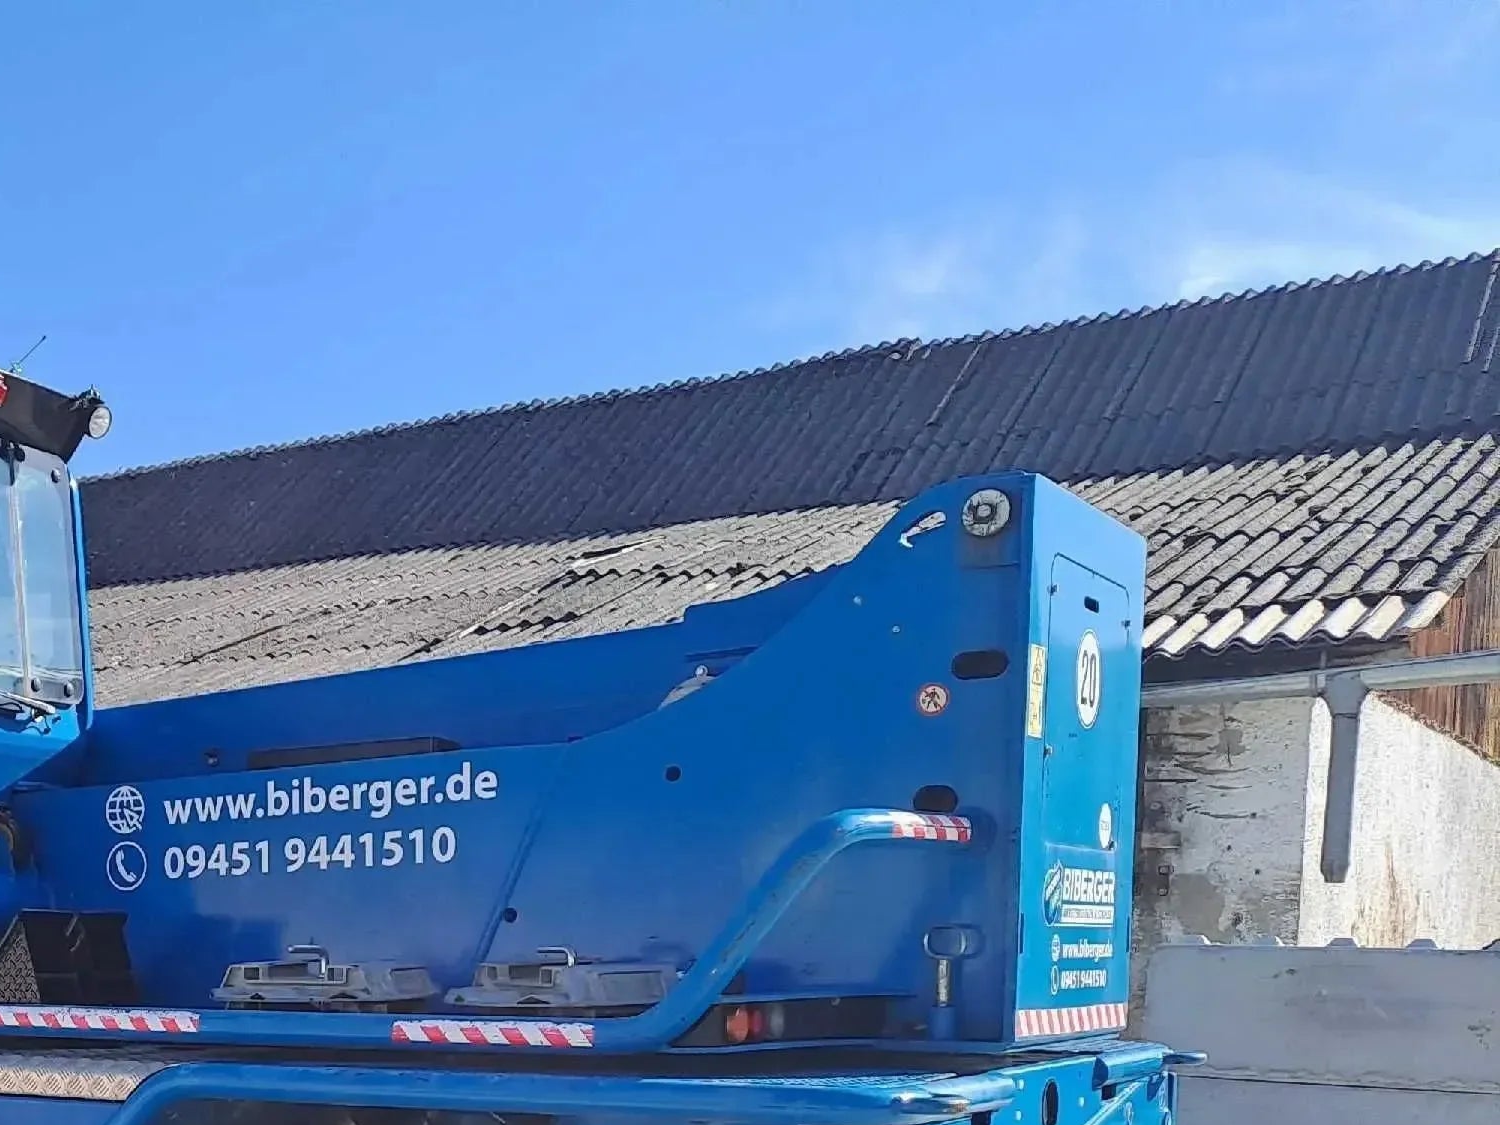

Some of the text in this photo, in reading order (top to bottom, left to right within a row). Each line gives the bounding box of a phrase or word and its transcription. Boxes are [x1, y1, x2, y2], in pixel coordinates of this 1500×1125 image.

[1080, 649, 1097, 708] 20
[163, 761, 498, 825] www.biberger.de
[163, 826, 457, 880] 09451 9441510
[1062, 868, 1116, 905] BIBERGER
